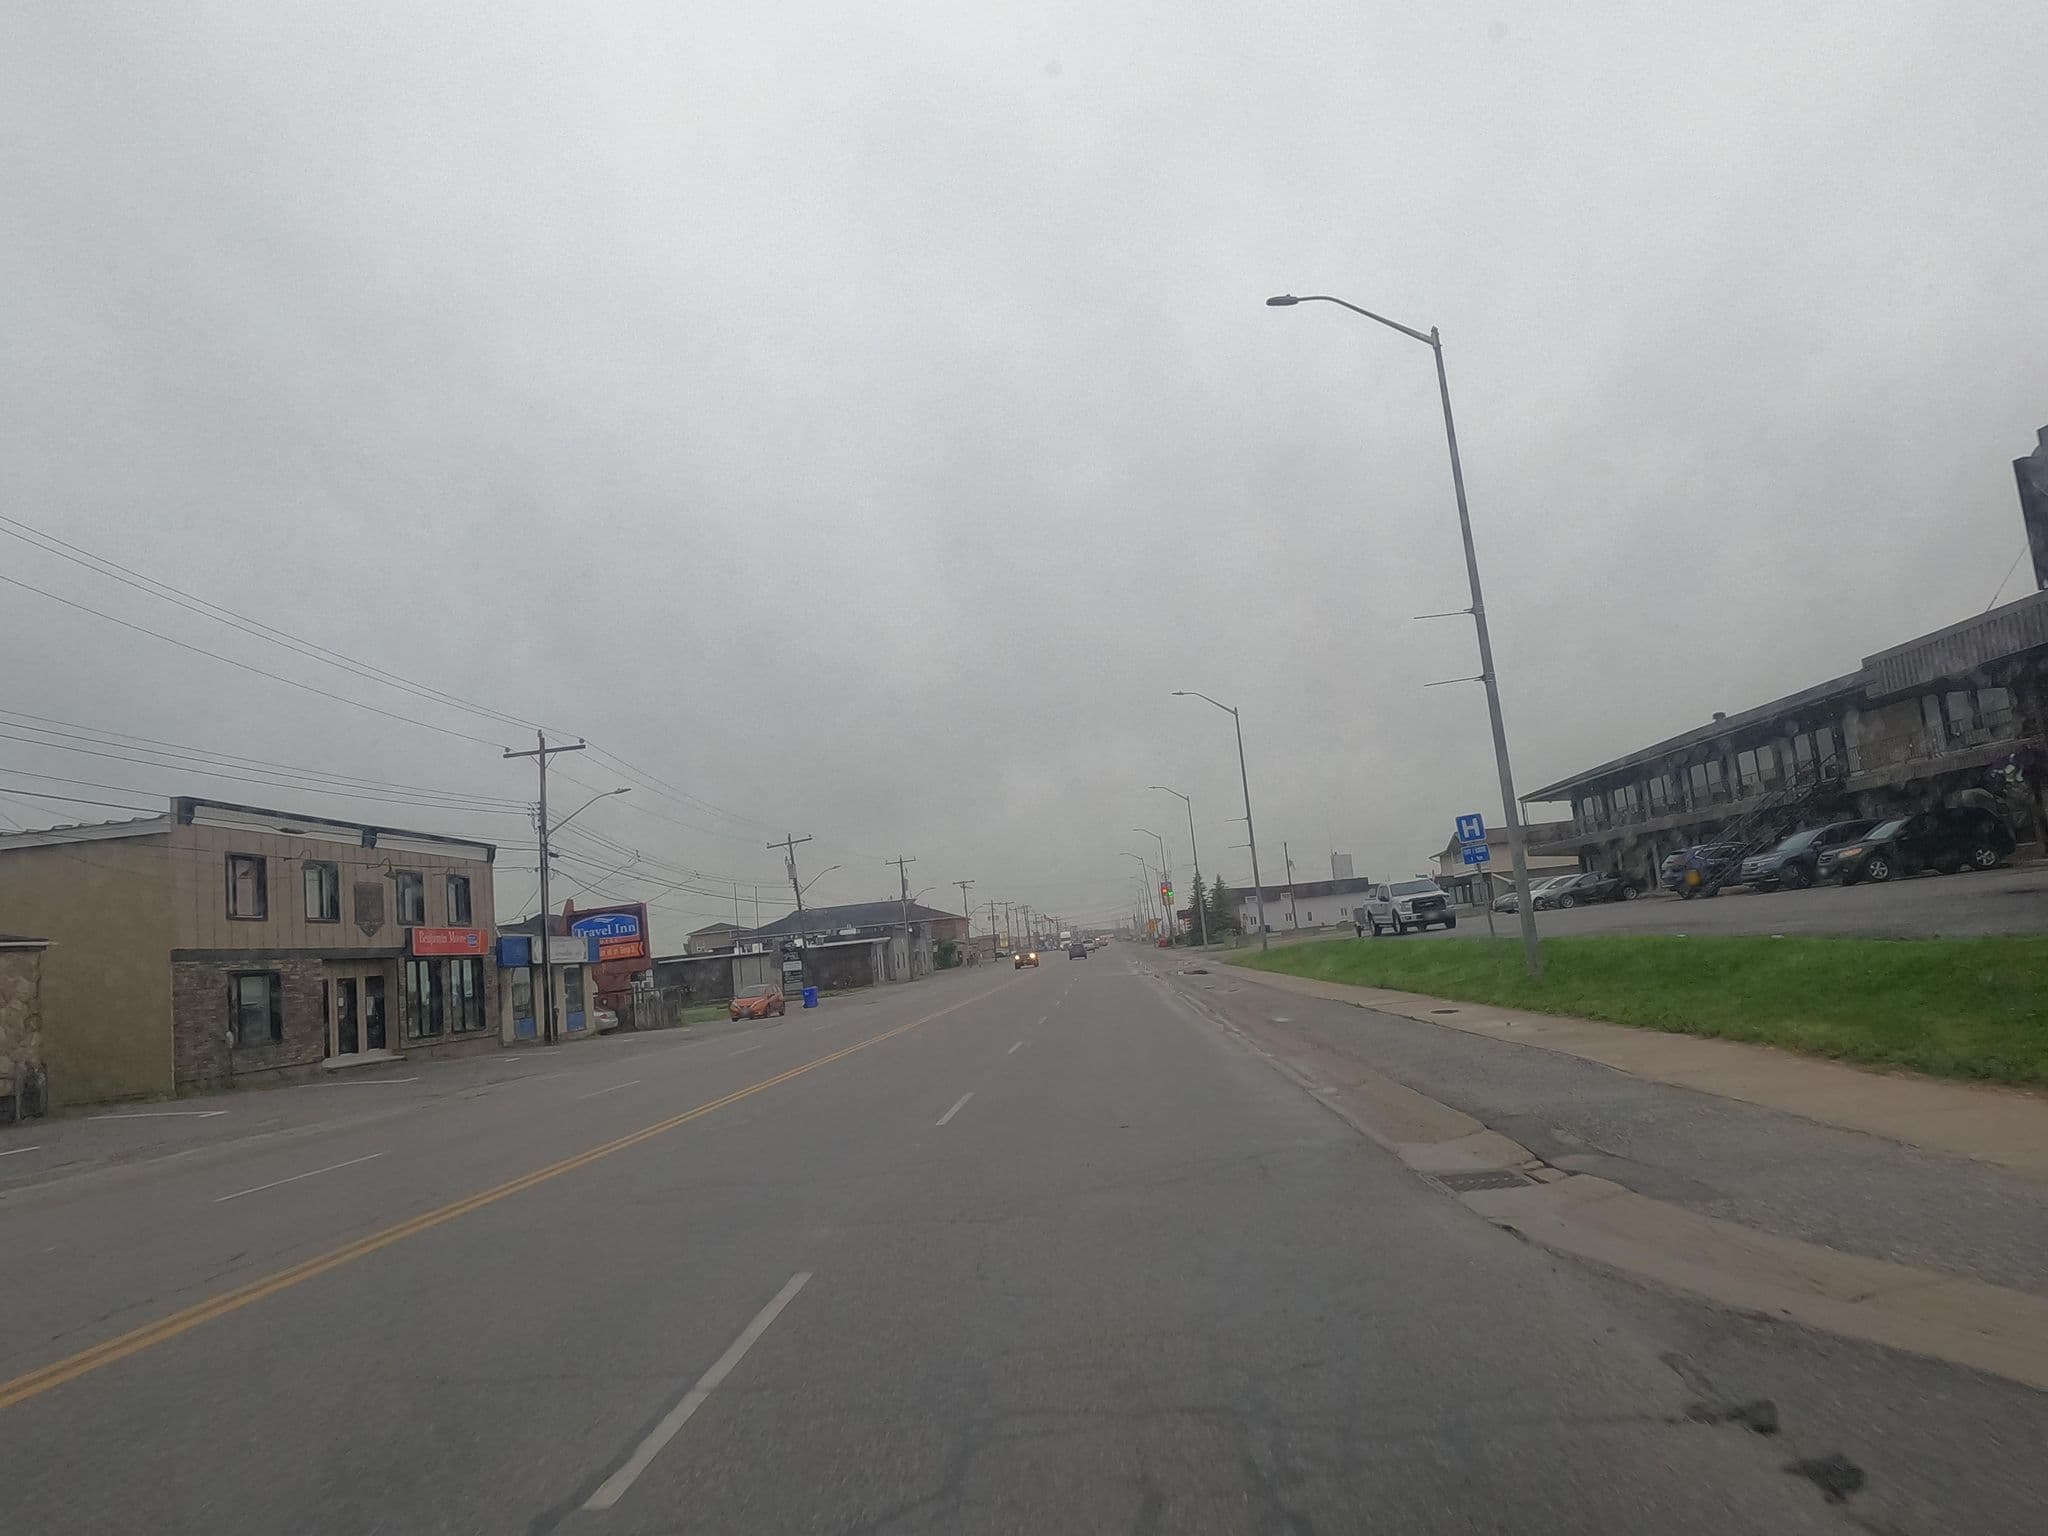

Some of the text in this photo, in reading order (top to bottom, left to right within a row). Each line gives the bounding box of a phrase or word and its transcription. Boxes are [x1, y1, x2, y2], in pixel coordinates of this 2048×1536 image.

[1461, 818, 1480, 838] H
[419, 930, 448, 946] Benjamin
[575, 923, 636, 938] Travel Inn
